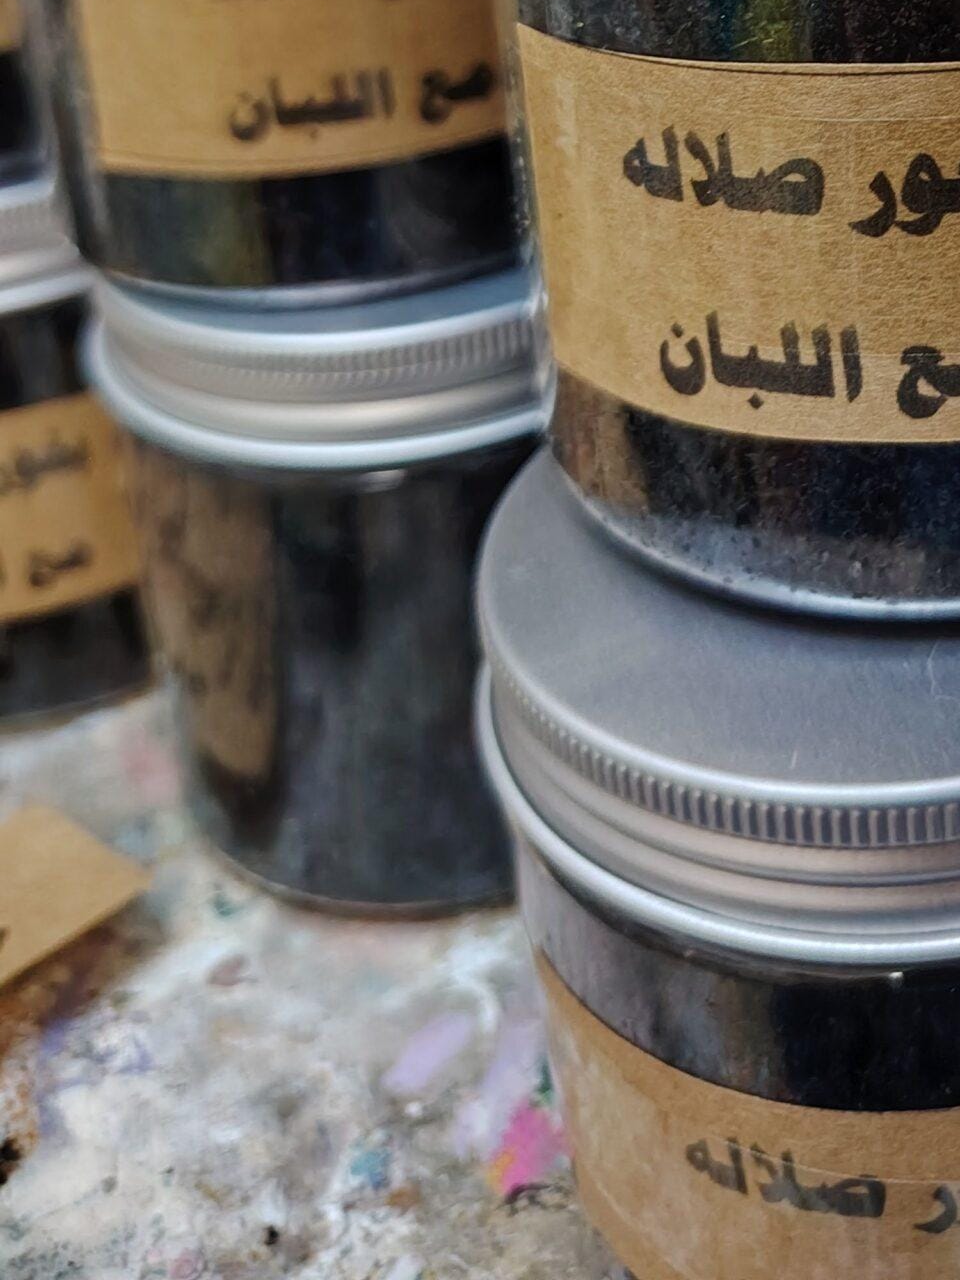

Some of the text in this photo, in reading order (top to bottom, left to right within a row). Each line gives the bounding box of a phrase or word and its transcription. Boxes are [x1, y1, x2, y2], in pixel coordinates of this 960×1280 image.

[227, 61, 497, 142] مع اللبان
[622, 125, 825, 217] صلاله
[659, 310, 864, 411] اللبان
[686, 1136, 887, 1218] صلاله
